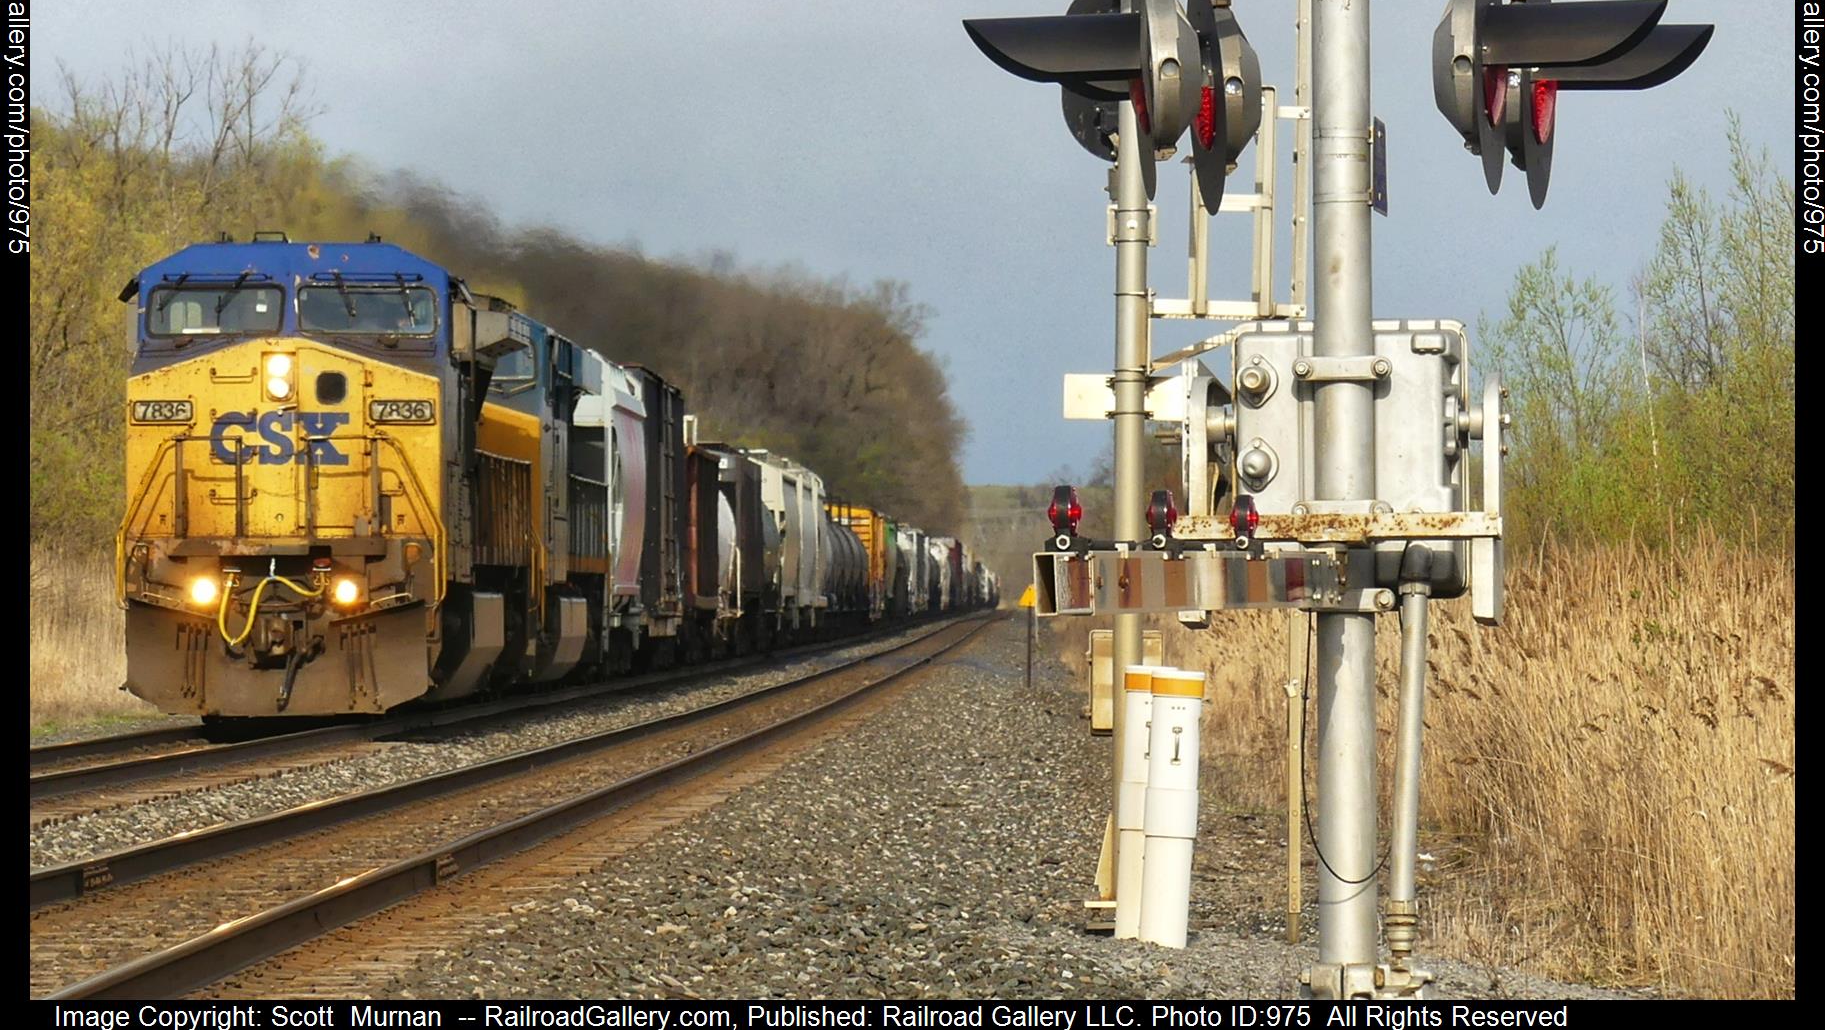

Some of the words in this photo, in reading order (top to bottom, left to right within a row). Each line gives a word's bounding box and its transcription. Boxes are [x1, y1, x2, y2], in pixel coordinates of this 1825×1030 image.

[139, 402, 187, 420] 7836
[376, 402, 426, 420] 7836
[210, 411, 350, 465] CSX
